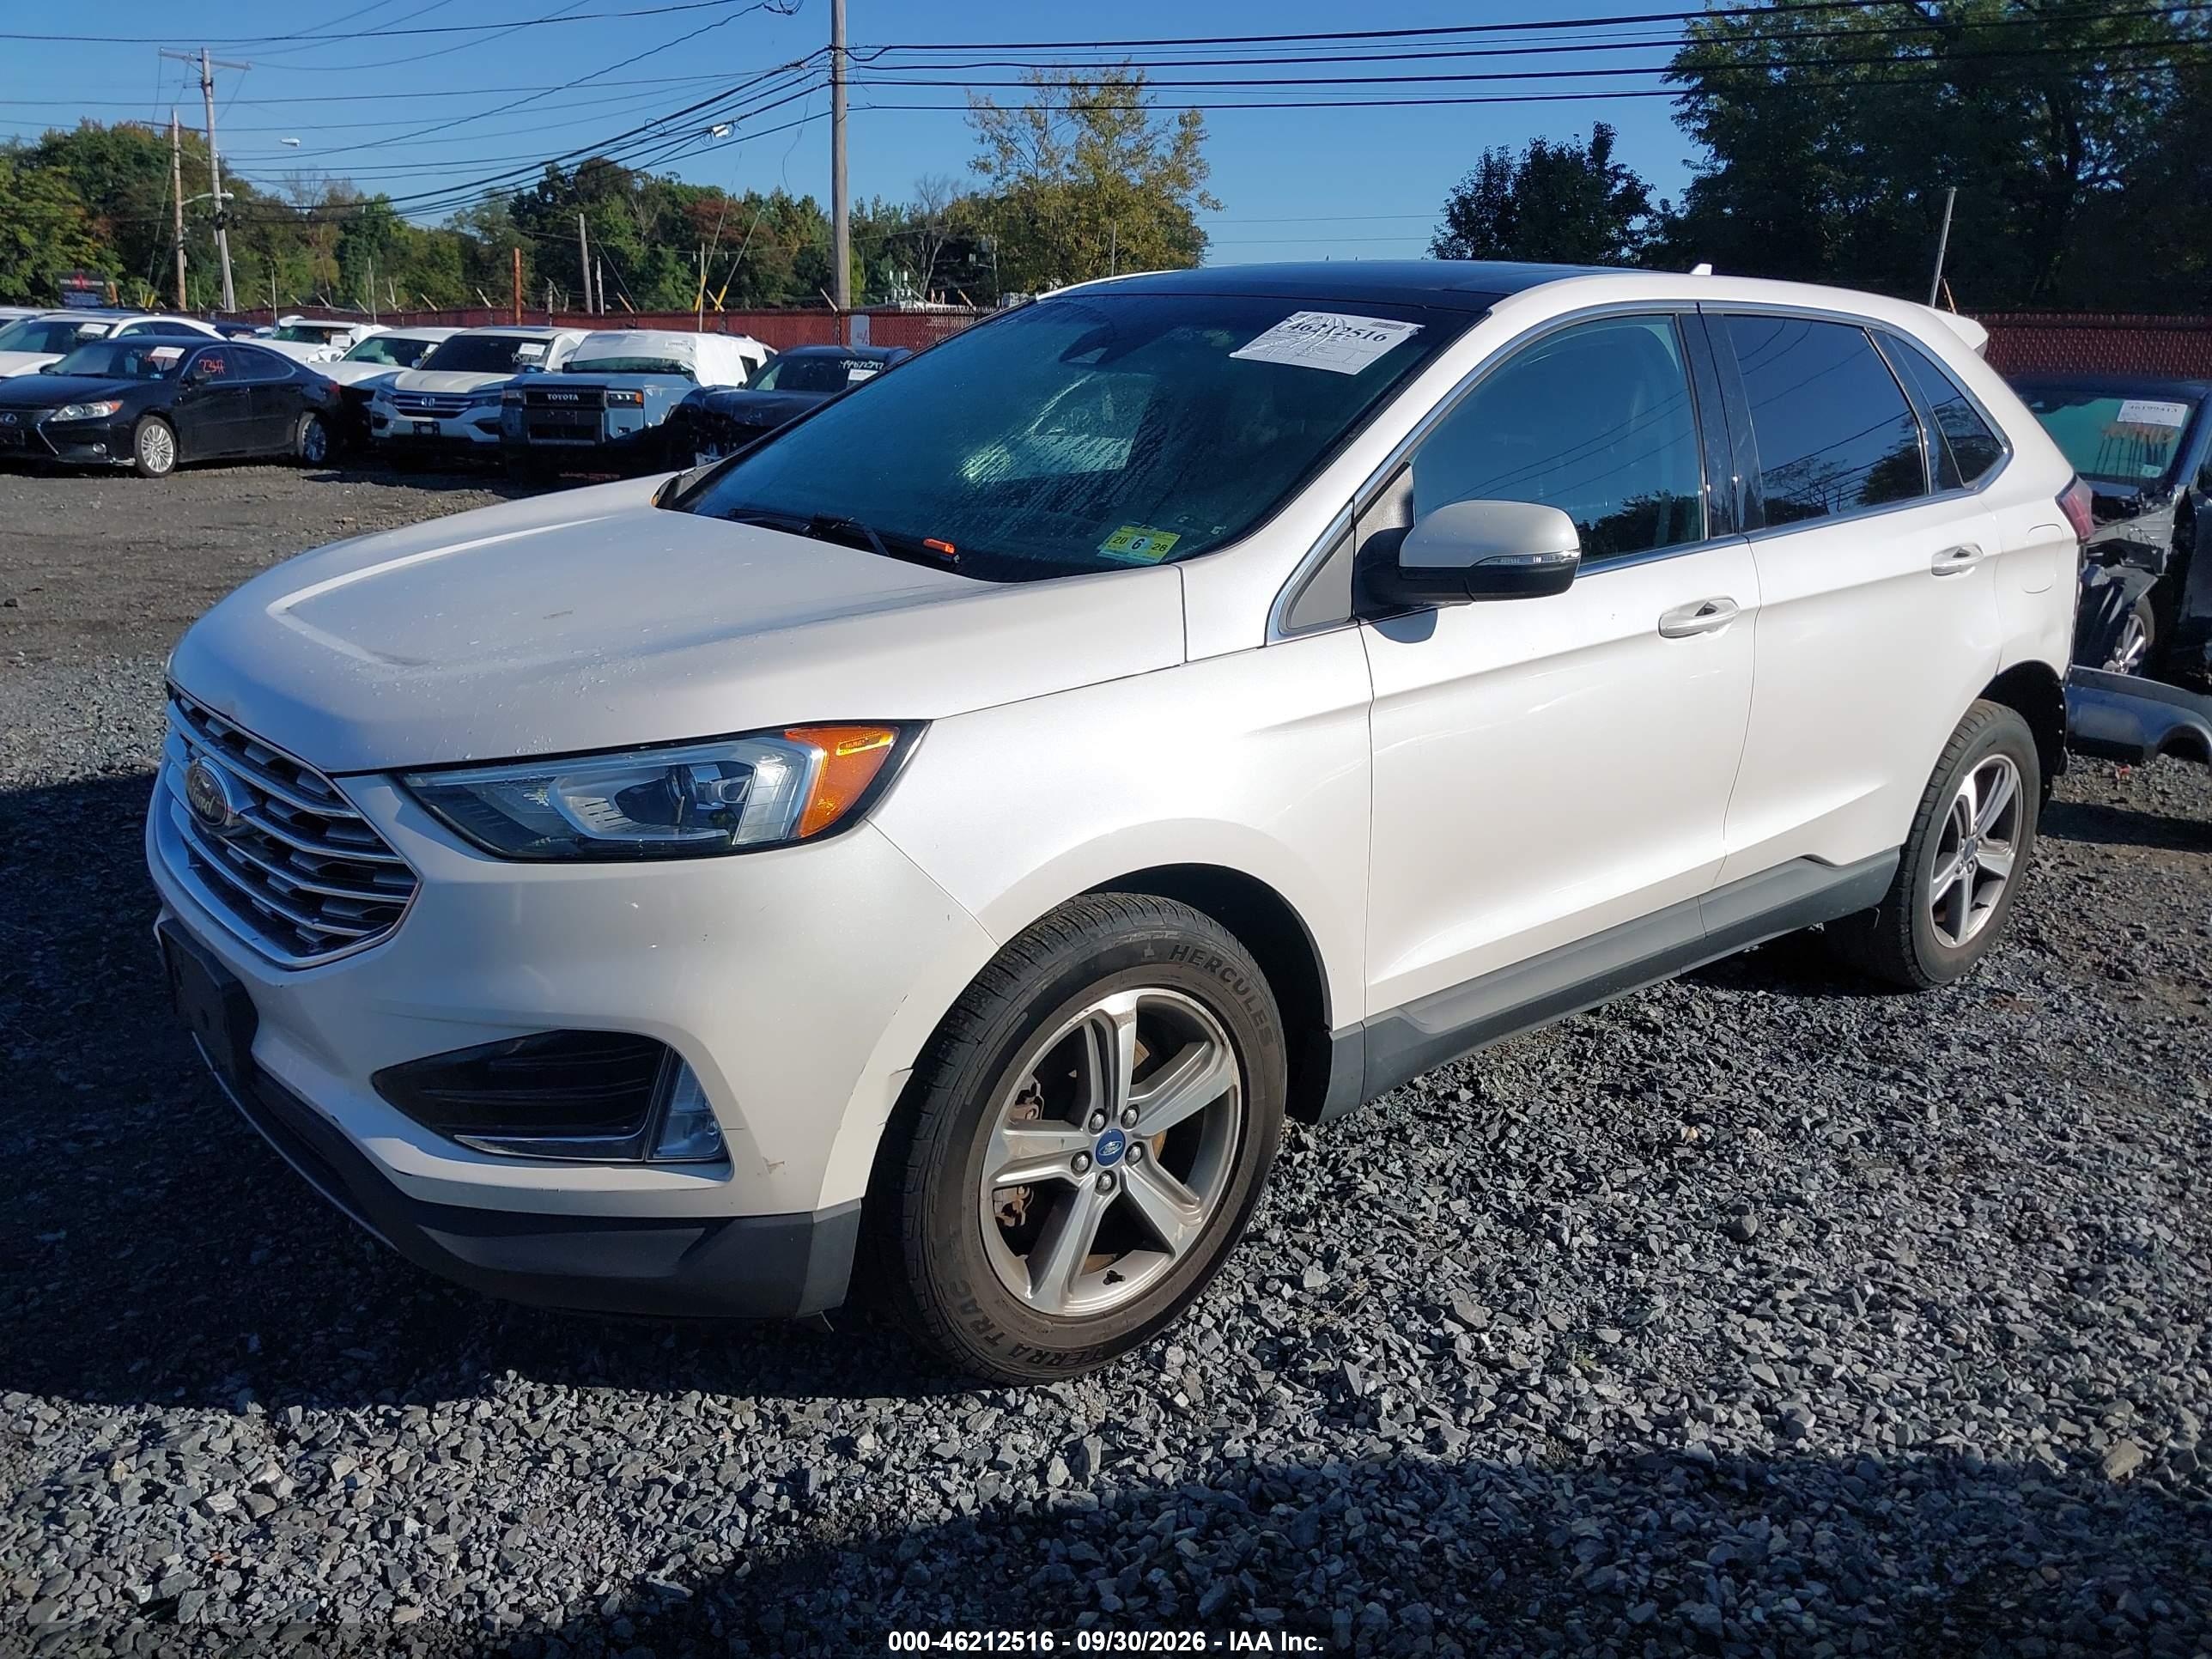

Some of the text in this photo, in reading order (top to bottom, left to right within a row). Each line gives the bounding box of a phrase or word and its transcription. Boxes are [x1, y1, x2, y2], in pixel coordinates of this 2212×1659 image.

[1288, 321, 1388, 343] 46212516
[1112, 536, 1169, 552] 20 6 28
[1169, 943, 1274, 1043] HERCULES
[1103, 1142, 1120, 1154] Ford
[949, 1279, 1006, 1347] TRAC
